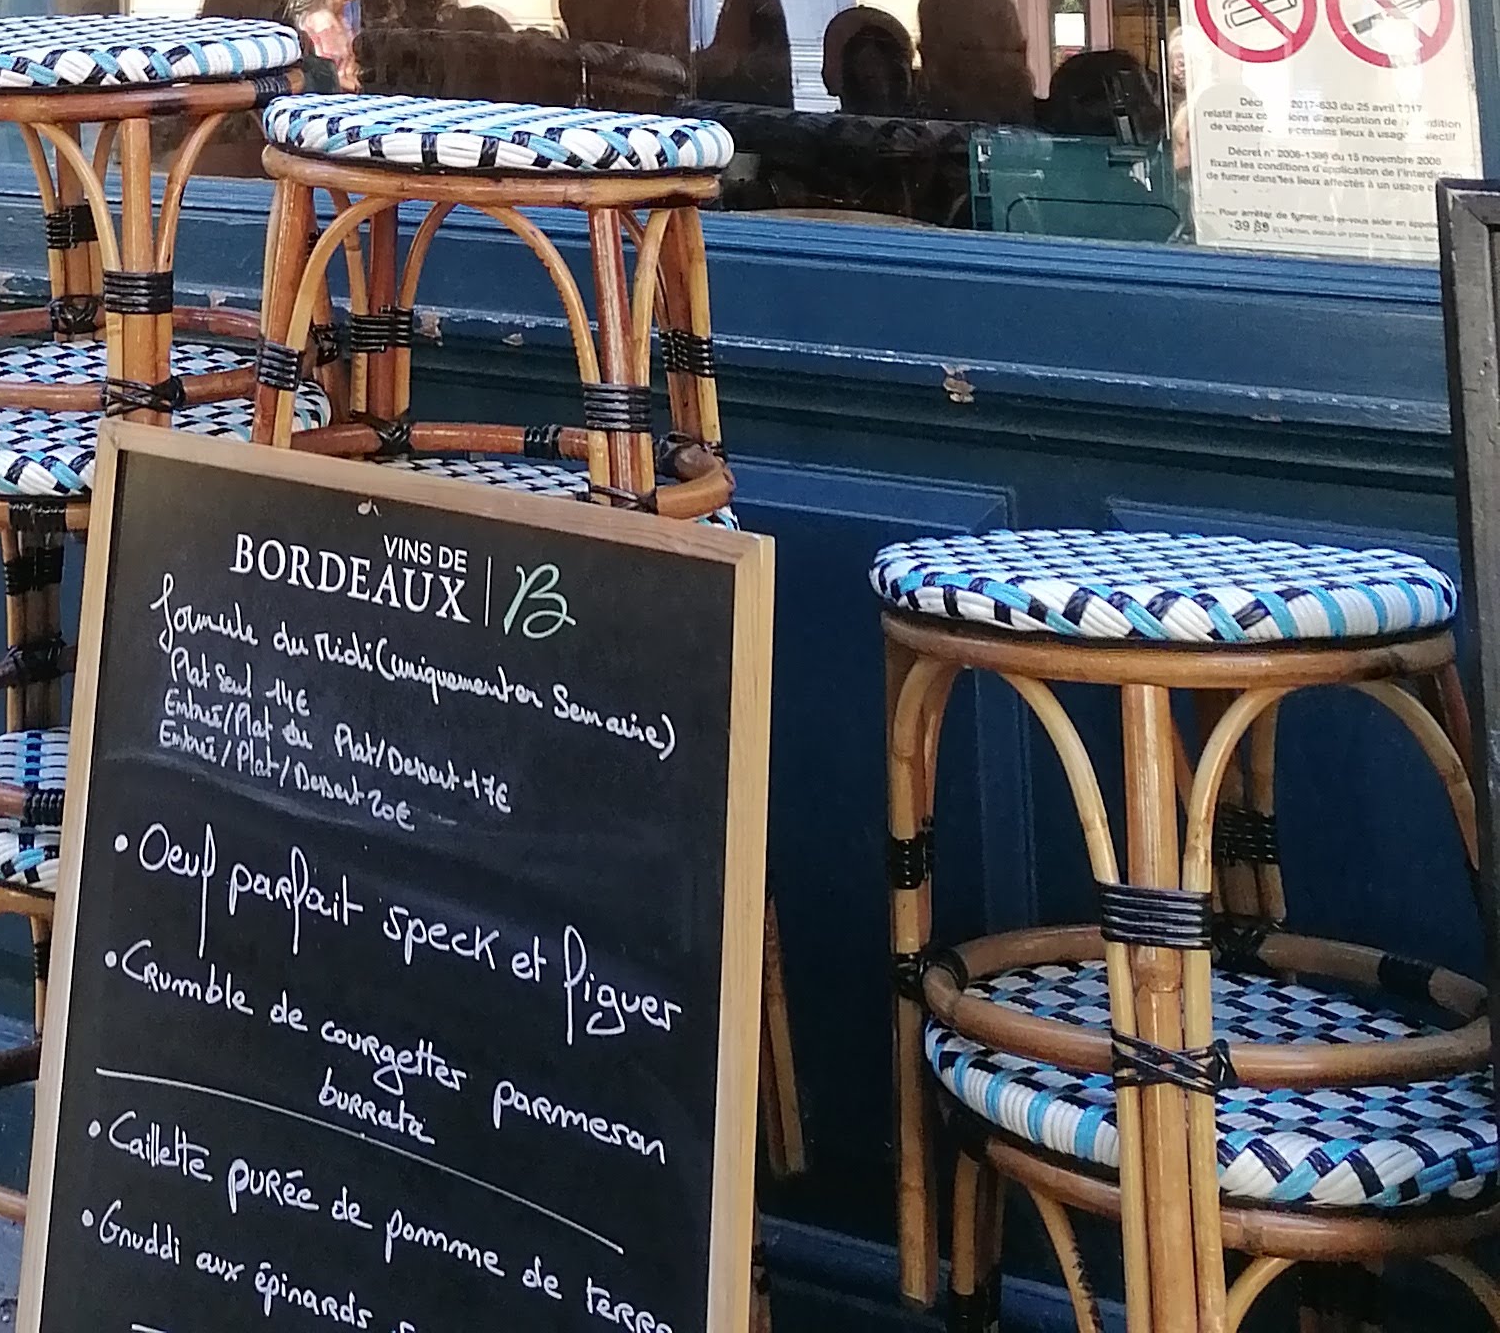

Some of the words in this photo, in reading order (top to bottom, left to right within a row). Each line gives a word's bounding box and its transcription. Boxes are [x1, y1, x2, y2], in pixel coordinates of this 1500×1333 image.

[1227, 145, 1262, 158] Décret
[1361, 154, 1415, 165] novembre
[1257, 161, 1310, 173] conditions
[229, 532, 472, 624] BORDEAUX
[383, 534, 432, 566] VINS
[437, 545, 469, 574] DE
[272, 620, 310, 657] du
[170, 646, 211, 691] Plat
[214, 662, 253, 699] Seul
[264, 677, 311, 717] 14€
[367, 788, 416, 832] 20€
[463, 767, 513, 814] 17€
[229, 844, 365, 955] parfait
[511, 935, 548, 982] et
[120, 938, 255, 1015] Crumble
[269, 989, 309, 1031] de
[320, 1019, 468, 1097] courgettes
[492, 1080, 666, 1165] parmesan
[317, 1066, 436, 1145] burrata
[107, 1109, 214, 1183] Caillette
[227, 1169, 320, 1214] purée
[331, 1184, 374, 1230] de
[385, 1208, 506, 1278] pomme
[521, 1255, 563, 1300] de
[99, 1199, 181, 1265] Gnuddi
[196, 1250, 246, 1283] aux
[253, 1261, 375, 1330] épinards
